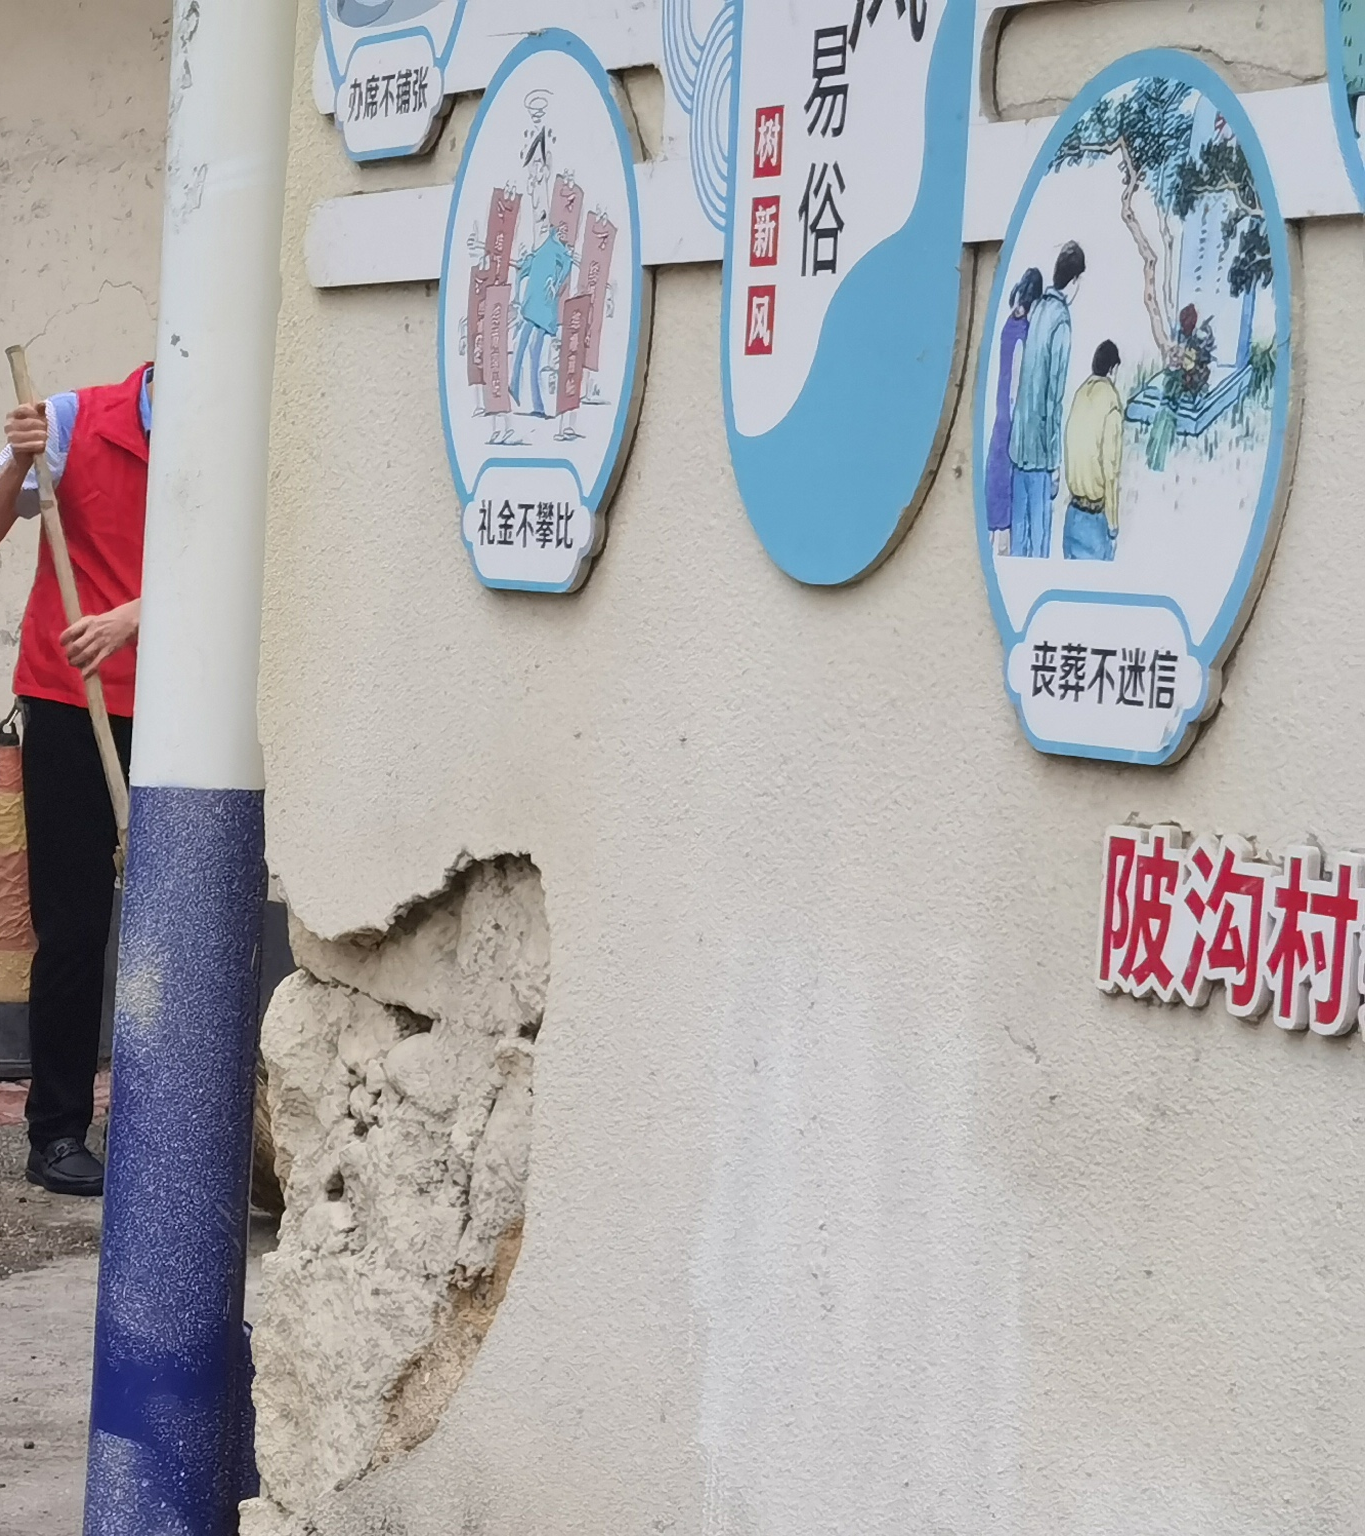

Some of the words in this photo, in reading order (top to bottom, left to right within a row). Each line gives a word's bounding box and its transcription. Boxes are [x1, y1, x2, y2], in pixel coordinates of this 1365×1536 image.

[747, 113, 781, 347] 树新风
[477, 499, 575, 549] 礼金不攀比
[1030, 640, 1179, 710] 丧葬不迷信
[1099, 835, 1359, 1026] 陂沟村
